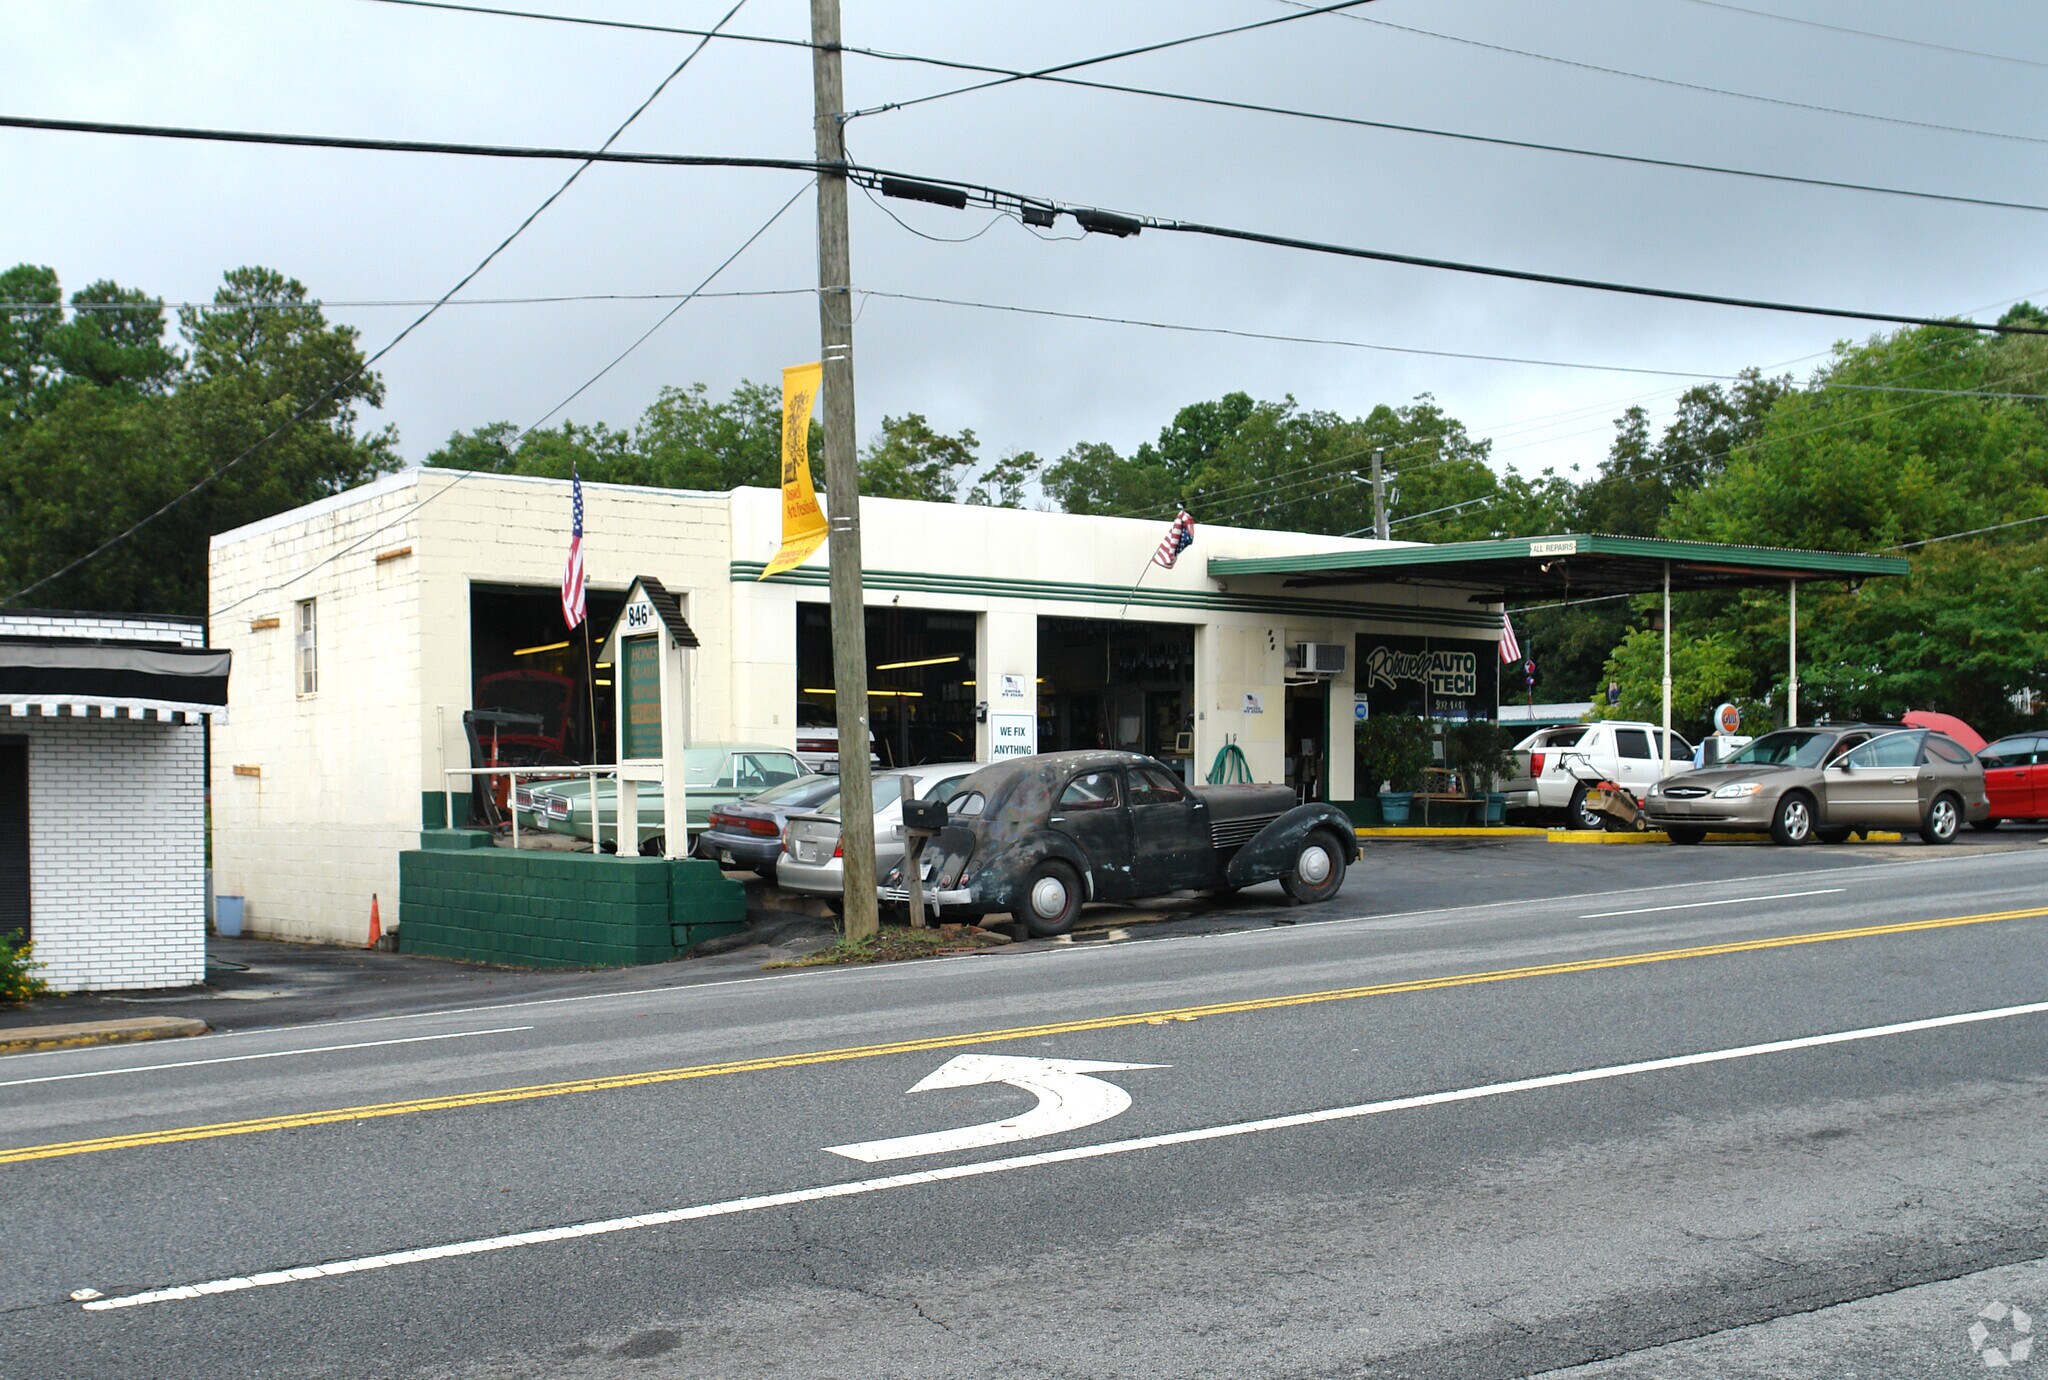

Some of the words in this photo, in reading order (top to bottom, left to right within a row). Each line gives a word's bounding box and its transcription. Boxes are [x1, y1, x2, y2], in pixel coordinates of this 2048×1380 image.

[1533, 544, 1544, 552] ALL
[1545, 543, 1574, 552] REPAIRS
[628, 604, 648, 627] 846
[631, 645, 658, 662] HONES
[1367, 646, 1432, 689] Roswell
[1431, 652, 1475, 674] AUTO
[1431, 673, 1475, 695] TECH
[1000, 727, 1012, 736] WE
[1013, 727, 1026, 736] FIX
[994, 745, 1031, 754] ANYTHING
